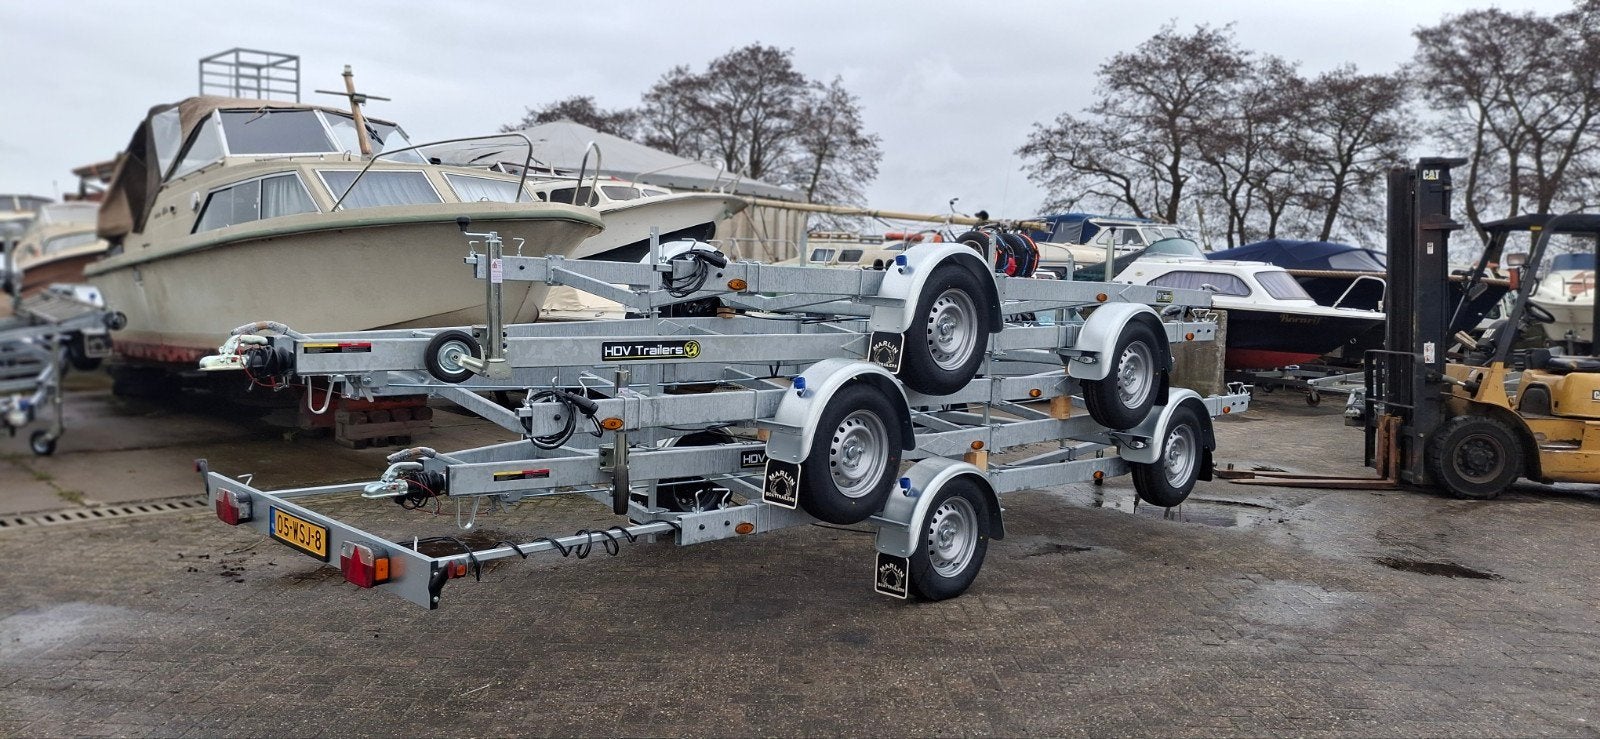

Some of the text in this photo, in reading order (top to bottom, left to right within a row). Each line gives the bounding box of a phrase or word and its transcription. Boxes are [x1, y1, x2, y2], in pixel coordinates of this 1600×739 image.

[1423, 169, 1440, 180] CAT
[604, 344, 683, 357] HDV Trailers
[872, 340, 899, 354] MARLIN
[743, 453, 766, 464] HDV
[768, 469, 796, 487] MARLIN
[277, 514, 322, 551] 05-WSJ-8
[879, 562, 905, 578] MARLIN
